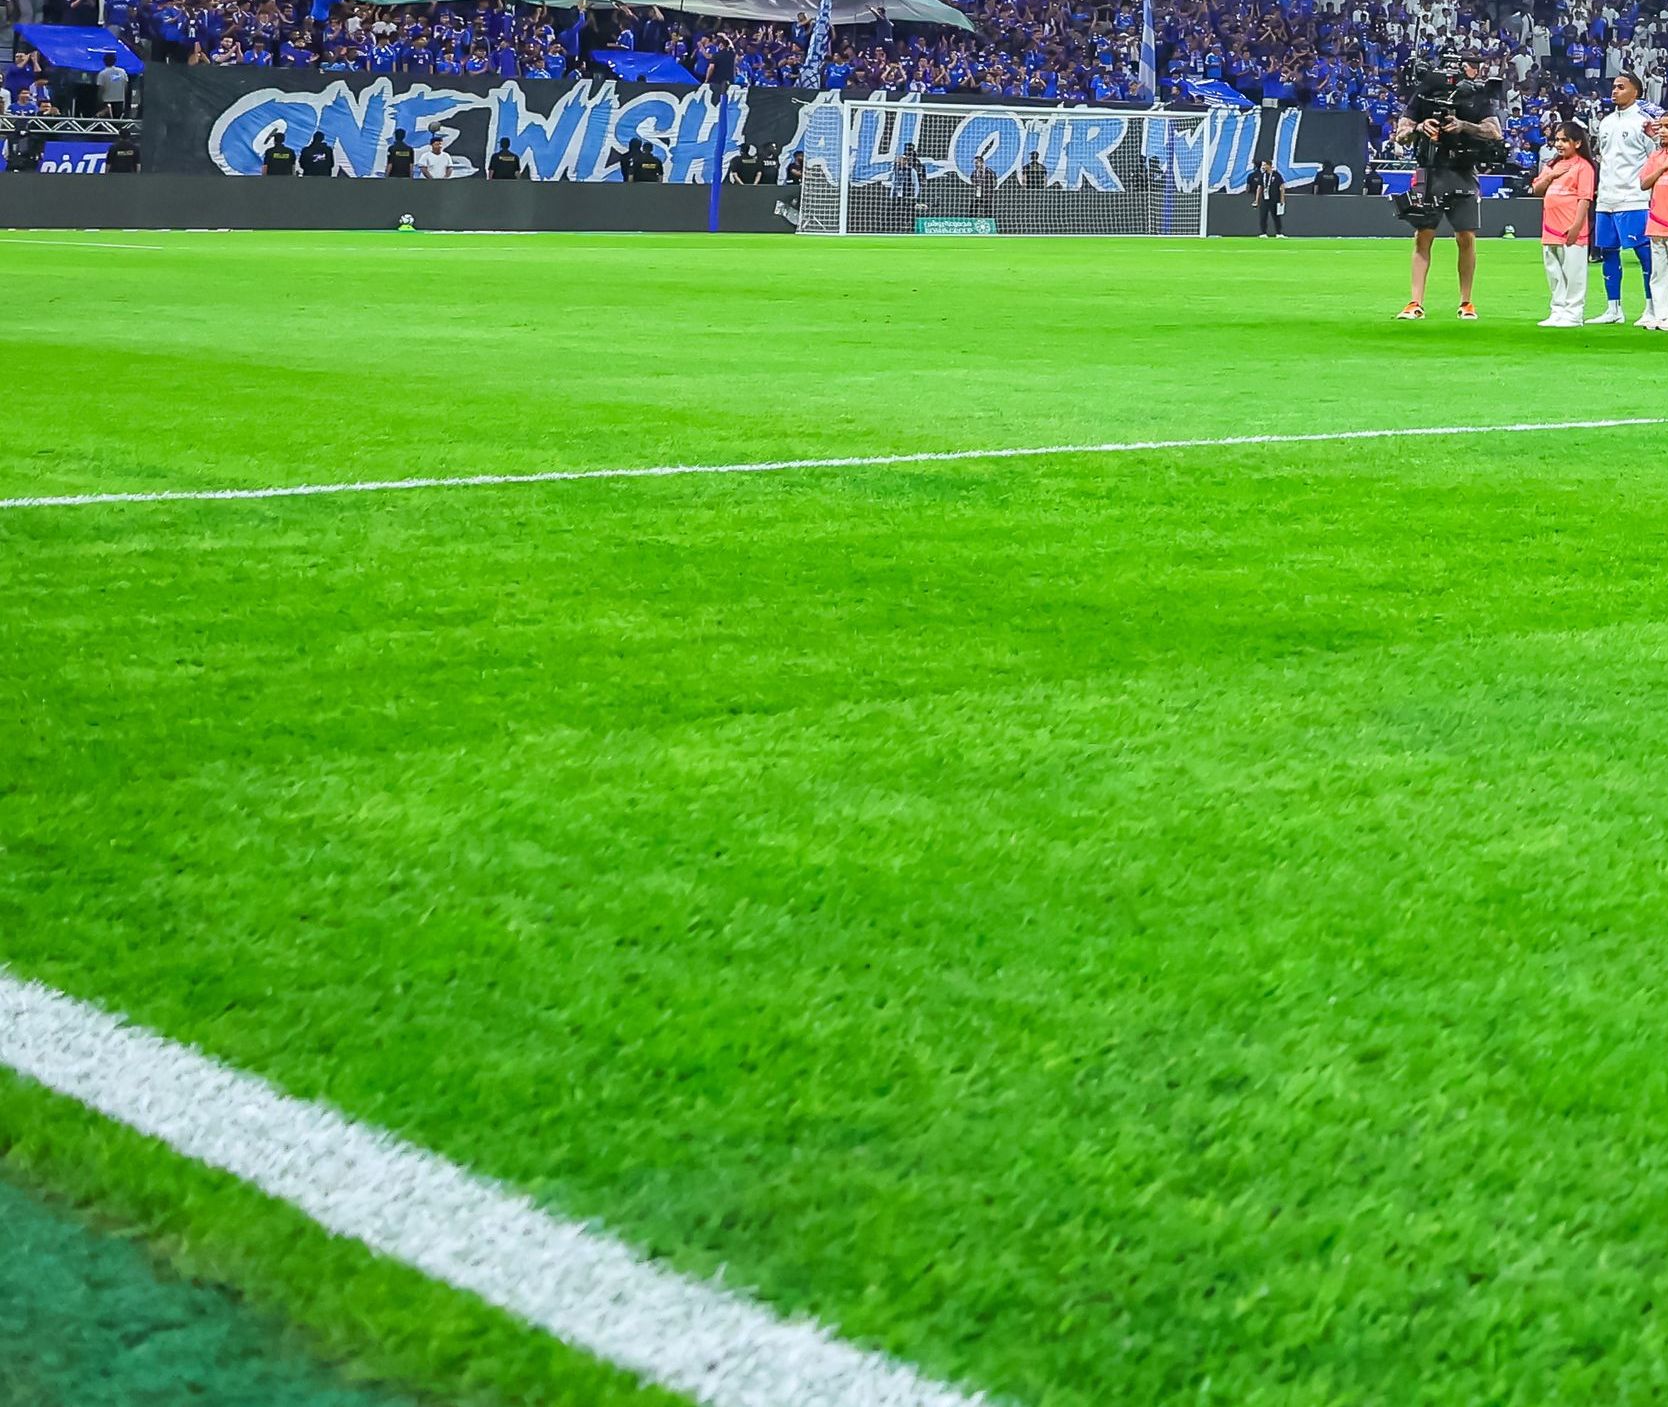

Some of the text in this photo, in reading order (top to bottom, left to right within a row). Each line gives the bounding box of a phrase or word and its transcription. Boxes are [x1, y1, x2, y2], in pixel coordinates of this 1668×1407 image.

[208, 76, 487, 180] ONE
[487, 78, 750, 185] WISH
[780, 89, 952, 190] ALL
[950, 106, 1127, 193] OUR
